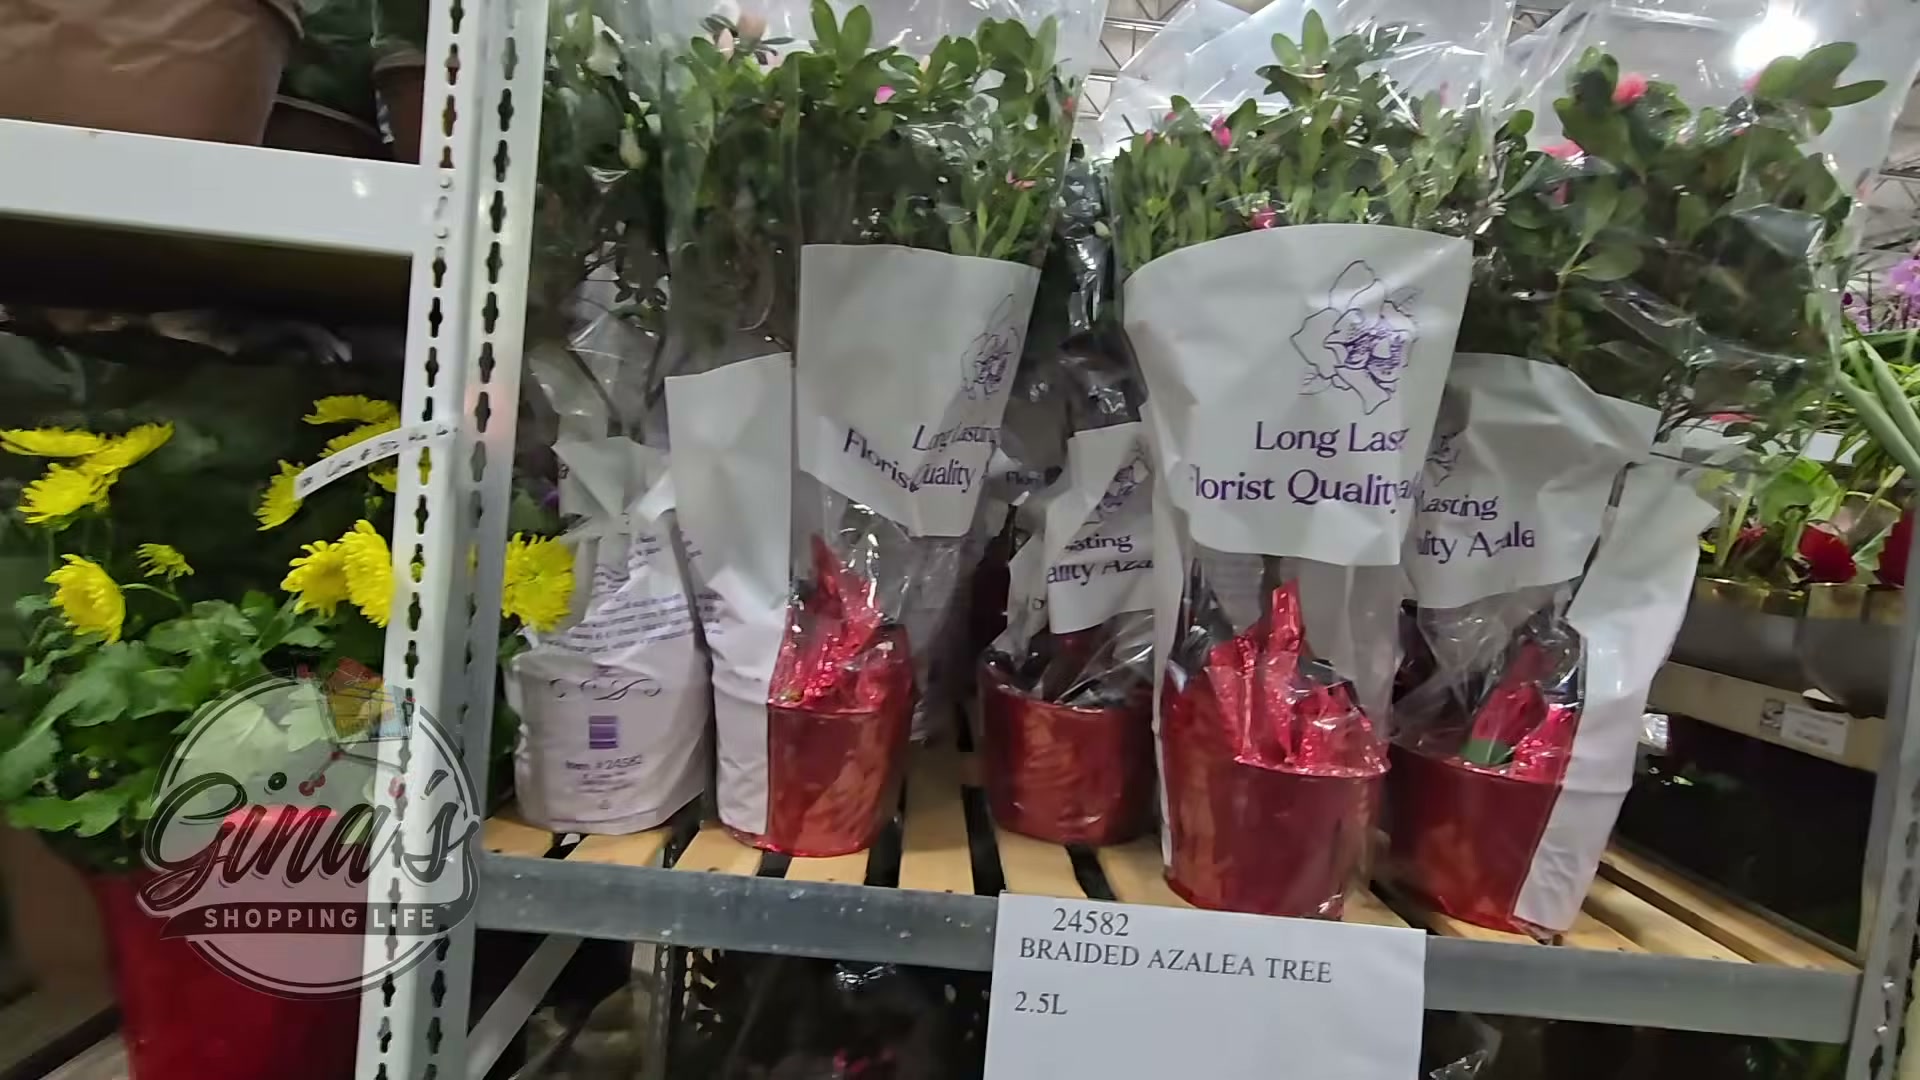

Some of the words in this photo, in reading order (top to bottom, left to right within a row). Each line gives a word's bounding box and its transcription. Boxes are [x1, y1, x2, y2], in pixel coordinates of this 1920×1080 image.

[1255, 421, 1341, 459] Long
[1349, 422, 1410, 452] Las
[1047, 561, 1097, 586] ality
[1101, 558, 1154, 576] Aza
[1052, 907, 1130, 938] 24582
[1019, 937, 1140, 967] BRAIDED
[1147, 949, 1256, 977] AZALEA
[1265, 957, 1333, 984] TREE
[1014, 991, 1068, 1016] 2.5L
